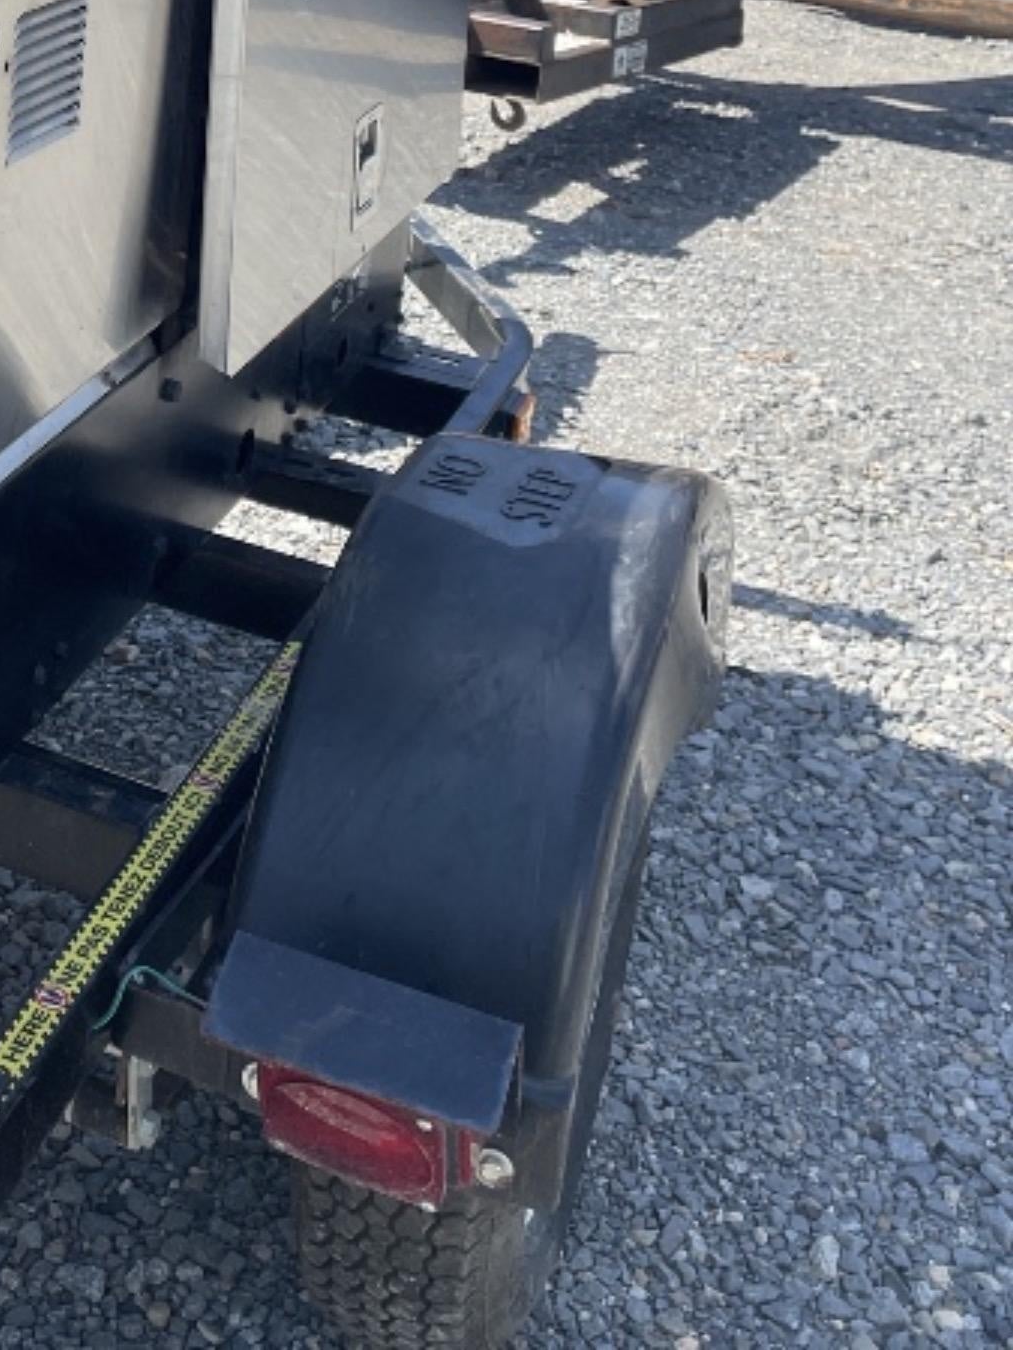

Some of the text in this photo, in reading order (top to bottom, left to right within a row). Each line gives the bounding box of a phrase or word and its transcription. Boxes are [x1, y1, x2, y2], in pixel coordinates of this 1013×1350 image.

[419, 455, 486, 497] NO
[500, 467, 577, 528] STEP
[56, 959, 84, 986] NE
[76, 923, 109, 956] PAS
[103, 871, 148, 922] TENEZ
[2, 1009, 49, 1063] HERE
